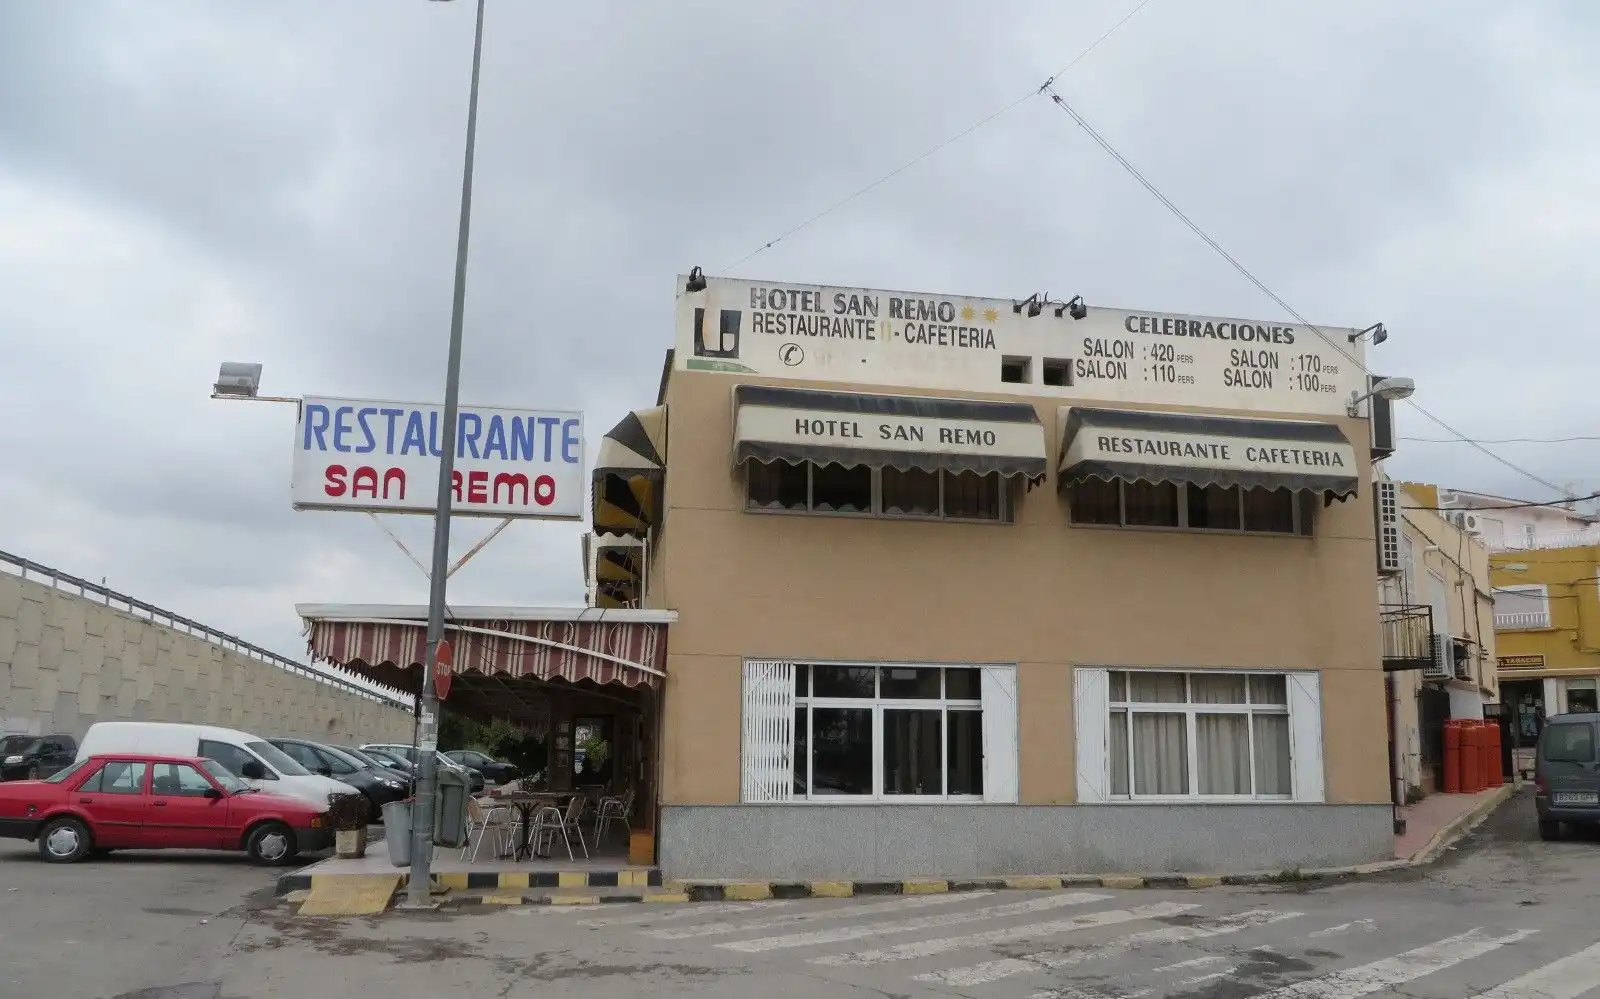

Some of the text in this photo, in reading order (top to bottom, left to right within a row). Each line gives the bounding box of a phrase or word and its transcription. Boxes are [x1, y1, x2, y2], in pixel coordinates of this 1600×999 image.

[750, 287, 956, 322] HOTEL SAN REMO
[752, 312, 876, 340] RESTAURANTE
[904, 322, 996, 350] CAFETERIA
[1125, 315, 1295, 345] CELEBRACIONES
[1083, 337, 1134, 360] SALON
[1176, 354, 1194, 364] PERS
[1230, 349, 1279, 370] SALON
[1322, 364, 1339, 375] PERS
[1076, 359, 1127, 380] SALON
[1177, 374, 1195, 385] PERS
[1224, 368, 1272, 389] SALON
[1320, 383, 1337, 393] PERS
[303, 404, 580, 463] RESTAURANTE
[795, 418, 996, 446] HOTEL SAN REMO
[1097, 436, 1344, 468] RESTAURANTE CAFETERIA
[324, 464, 406, 500] SAN
[437, 662, 451, 677] STOP
